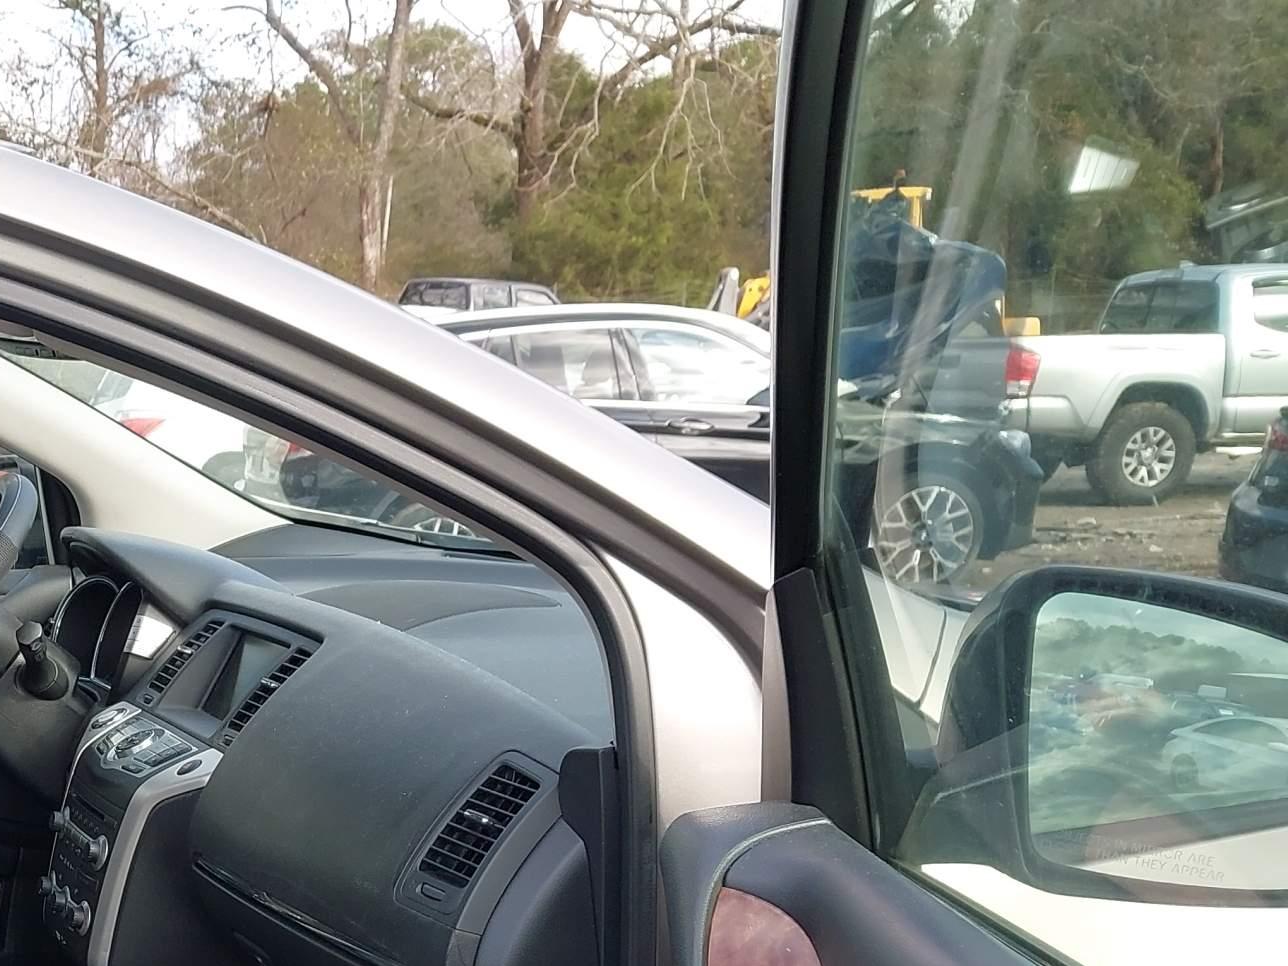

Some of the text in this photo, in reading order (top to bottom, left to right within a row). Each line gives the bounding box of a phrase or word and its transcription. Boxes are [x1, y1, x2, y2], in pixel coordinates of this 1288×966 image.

[1187, 851, 1217, 867] ARE
[1135, 857, 1167, 870] THEY
[1171, 862, 1225, 882] APPEAR
